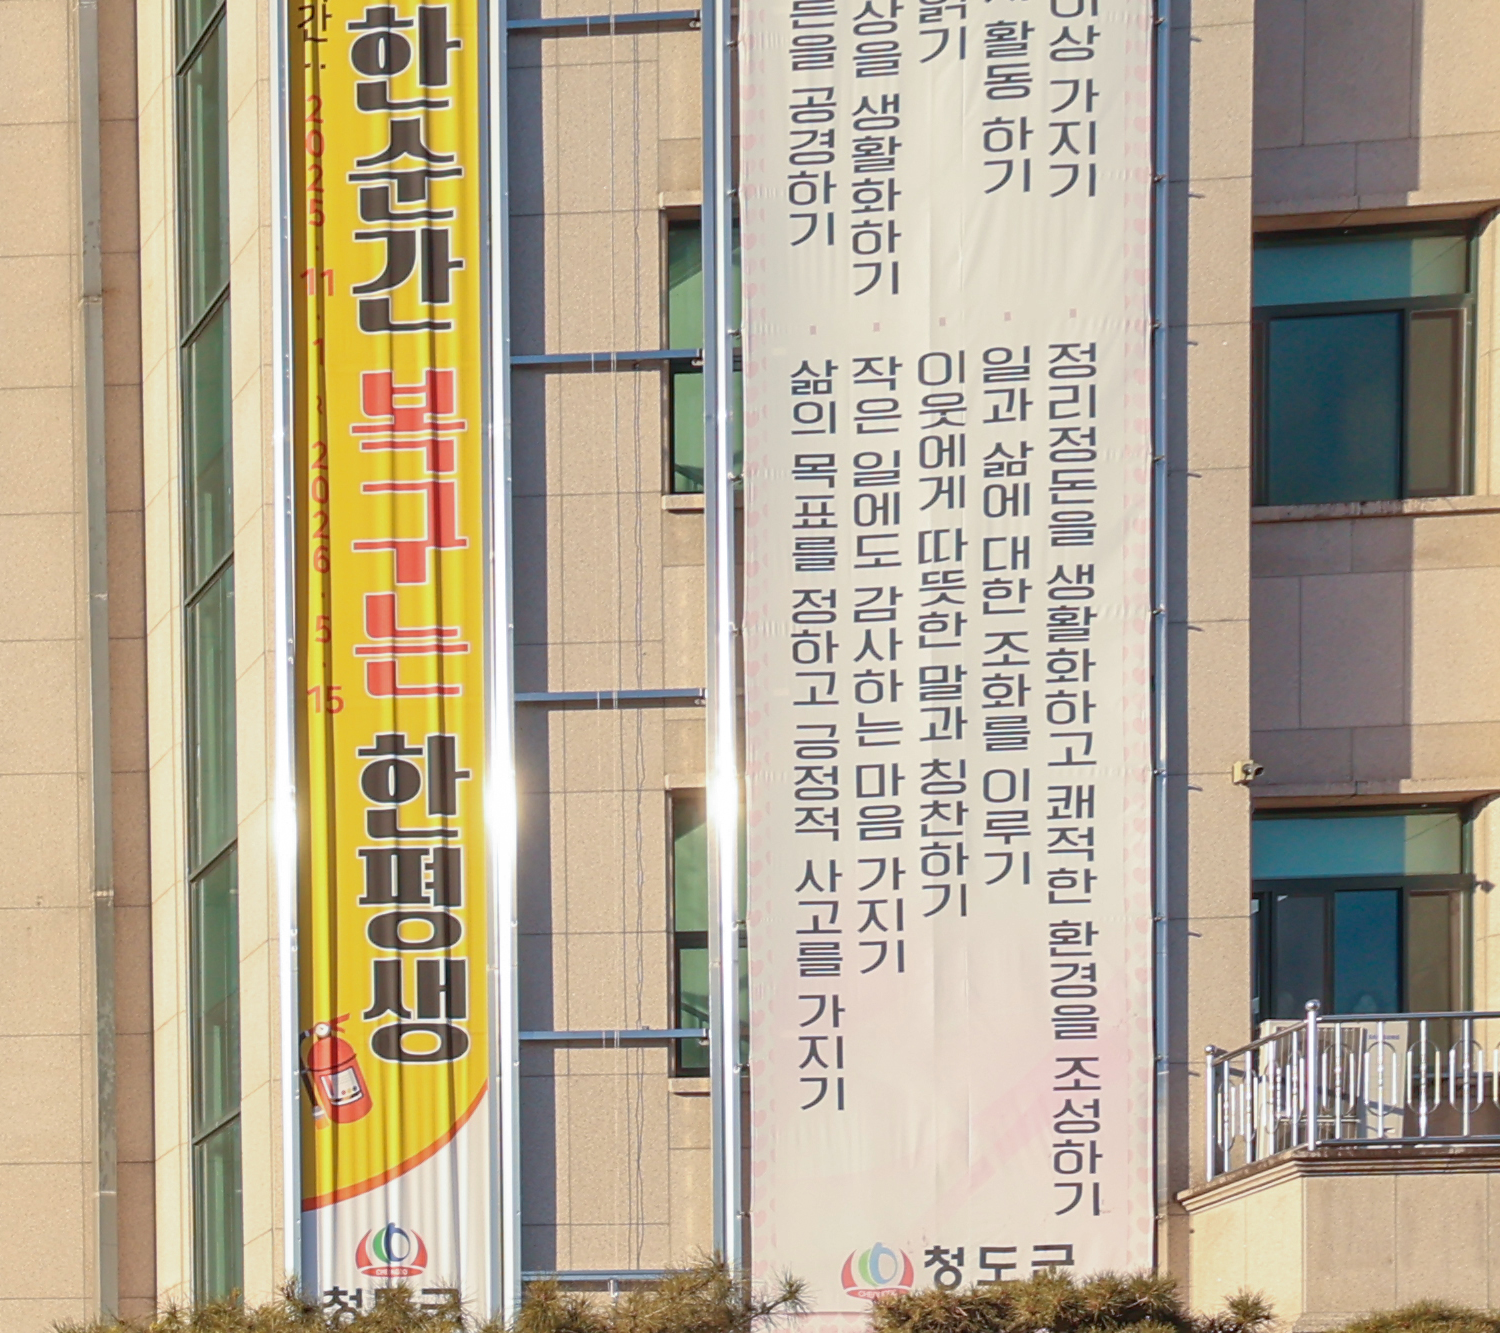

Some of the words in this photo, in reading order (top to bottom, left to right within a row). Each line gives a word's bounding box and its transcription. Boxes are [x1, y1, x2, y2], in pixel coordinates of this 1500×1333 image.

[983, 19, 1035, 100] 활동
[347, 5, 463, 332] 한순간
[787, 86, 838, 247] 공경하기
[851, 93, 902, 297] 생활화하기
[982, 116, 1034, 195] 하기
[1048, 78, 1100, 198] 가지기
[789, 357, 839, 436] 삶의
[851, 355, 904, 436] 작은
[916, 349, 968, 512] 이웃에게
[981, 344, 1034, 425] 일과
[1047, 340, 1099, 548] 정리정돈을
[351, 368, 470, 697] 복구는
[790, 452, 839, 573] 목표를
[852, 449, 904, 570] 일에도
[981, 439, 1034, 519] 삶에
[917, 527, 968, 650] 따뜻한
[981, 534, 1033, 616] 대한
[790, 587, 840, 707] 정하고
[852, 585, 904, 748] 감사하는
[918, 663, 969, 743] 말과
[981, 630, 1033, 753] 조화를
[1046, 563, 1099, 768] 생활화하고
[792, 722, 841, 842] 긍정적
[854, 762, 906, 842] 마음
[918, 757, 969, 918] 칭찬하기
[982, 767, 1032, 887] 이루기
[357, 733, 472, 1064] 한평생
[1046, 783, 1099, 905] 쾌적한
[794, 858, 844, 978] 사고를
[856, 856, 906, 975] 가지기
[1048, 918, 1101, 1041] 환경을
[797, 993, 846, 1112] 가지기
[1051, 1056, 1104, 1218] 조성하기
